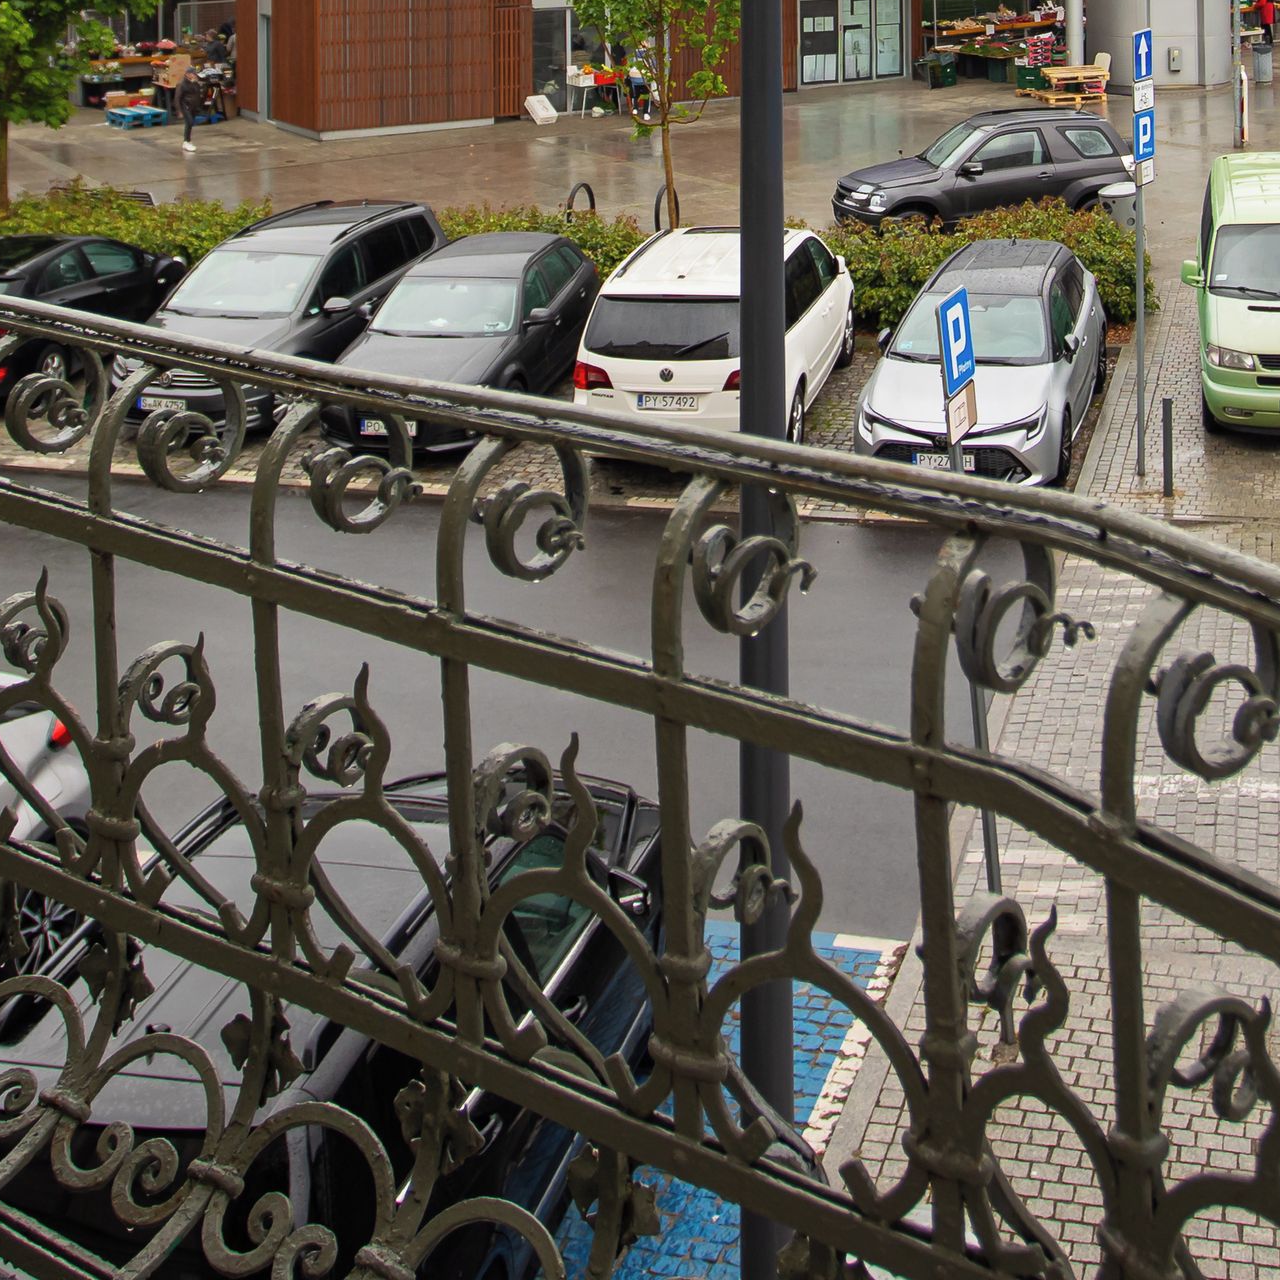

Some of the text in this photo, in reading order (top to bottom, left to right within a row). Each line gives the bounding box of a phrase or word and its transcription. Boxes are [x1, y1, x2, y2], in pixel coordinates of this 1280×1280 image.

[644, 395, 695, 408] PY 57492
[919, 454, 973, 468] PY 27H
